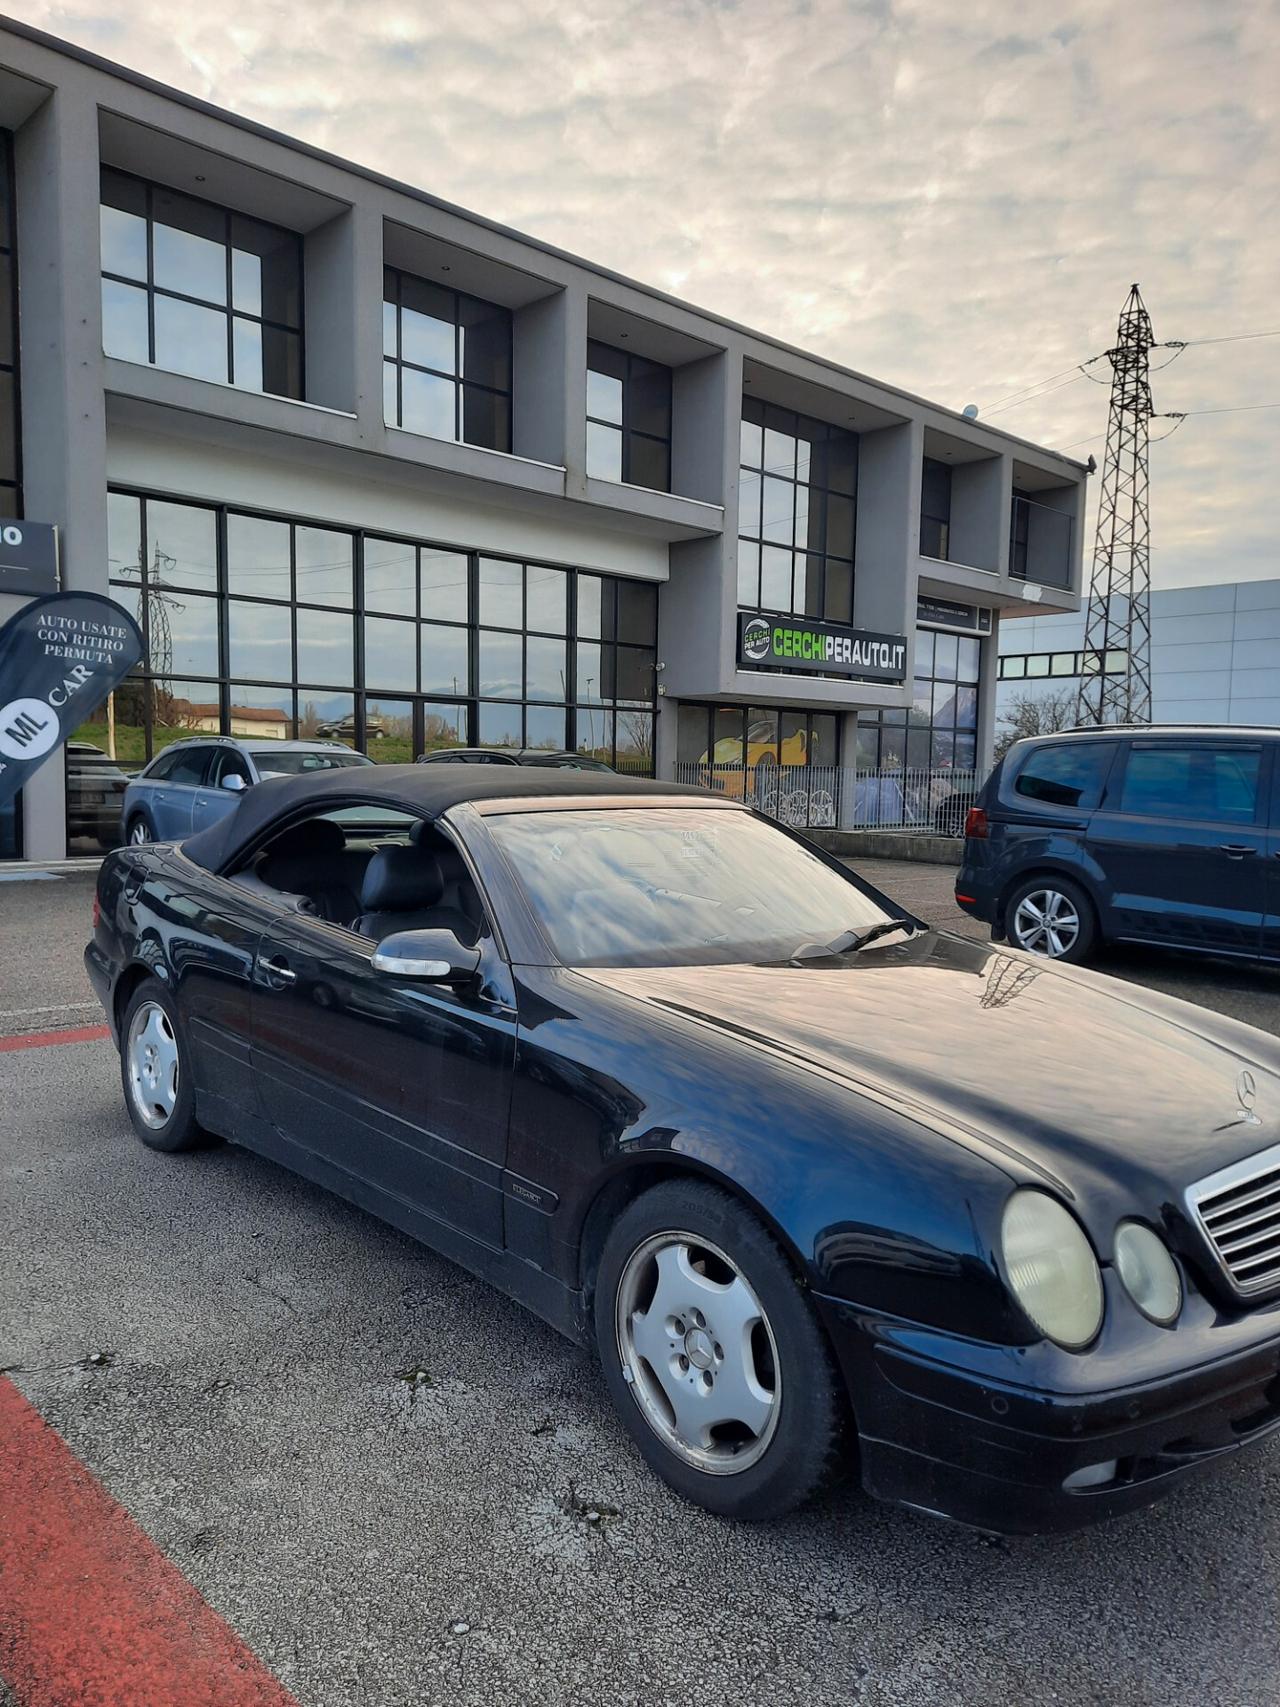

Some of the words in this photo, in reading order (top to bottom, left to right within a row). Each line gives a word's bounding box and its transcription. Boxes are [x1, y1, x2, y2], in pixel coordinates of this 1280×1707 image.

[36, 614, 78, 631] AUTO
[81, 620, 128, 640] USATE
[744, 627, 771, 643] CERCHI
[37, 628, 69, 644] CON
[72, 633, 124, 652] RITIRO
[744, 640, 755, 650] PER
[755, 636, 771, 647] AUTO
[773, 627, 905, 670] CERCHIPERAUTO.IT
[44, 643, 114, 665] PERMUTA
[5, 711, 49, 748] ML
[48, 663, 95, 708] CAR
